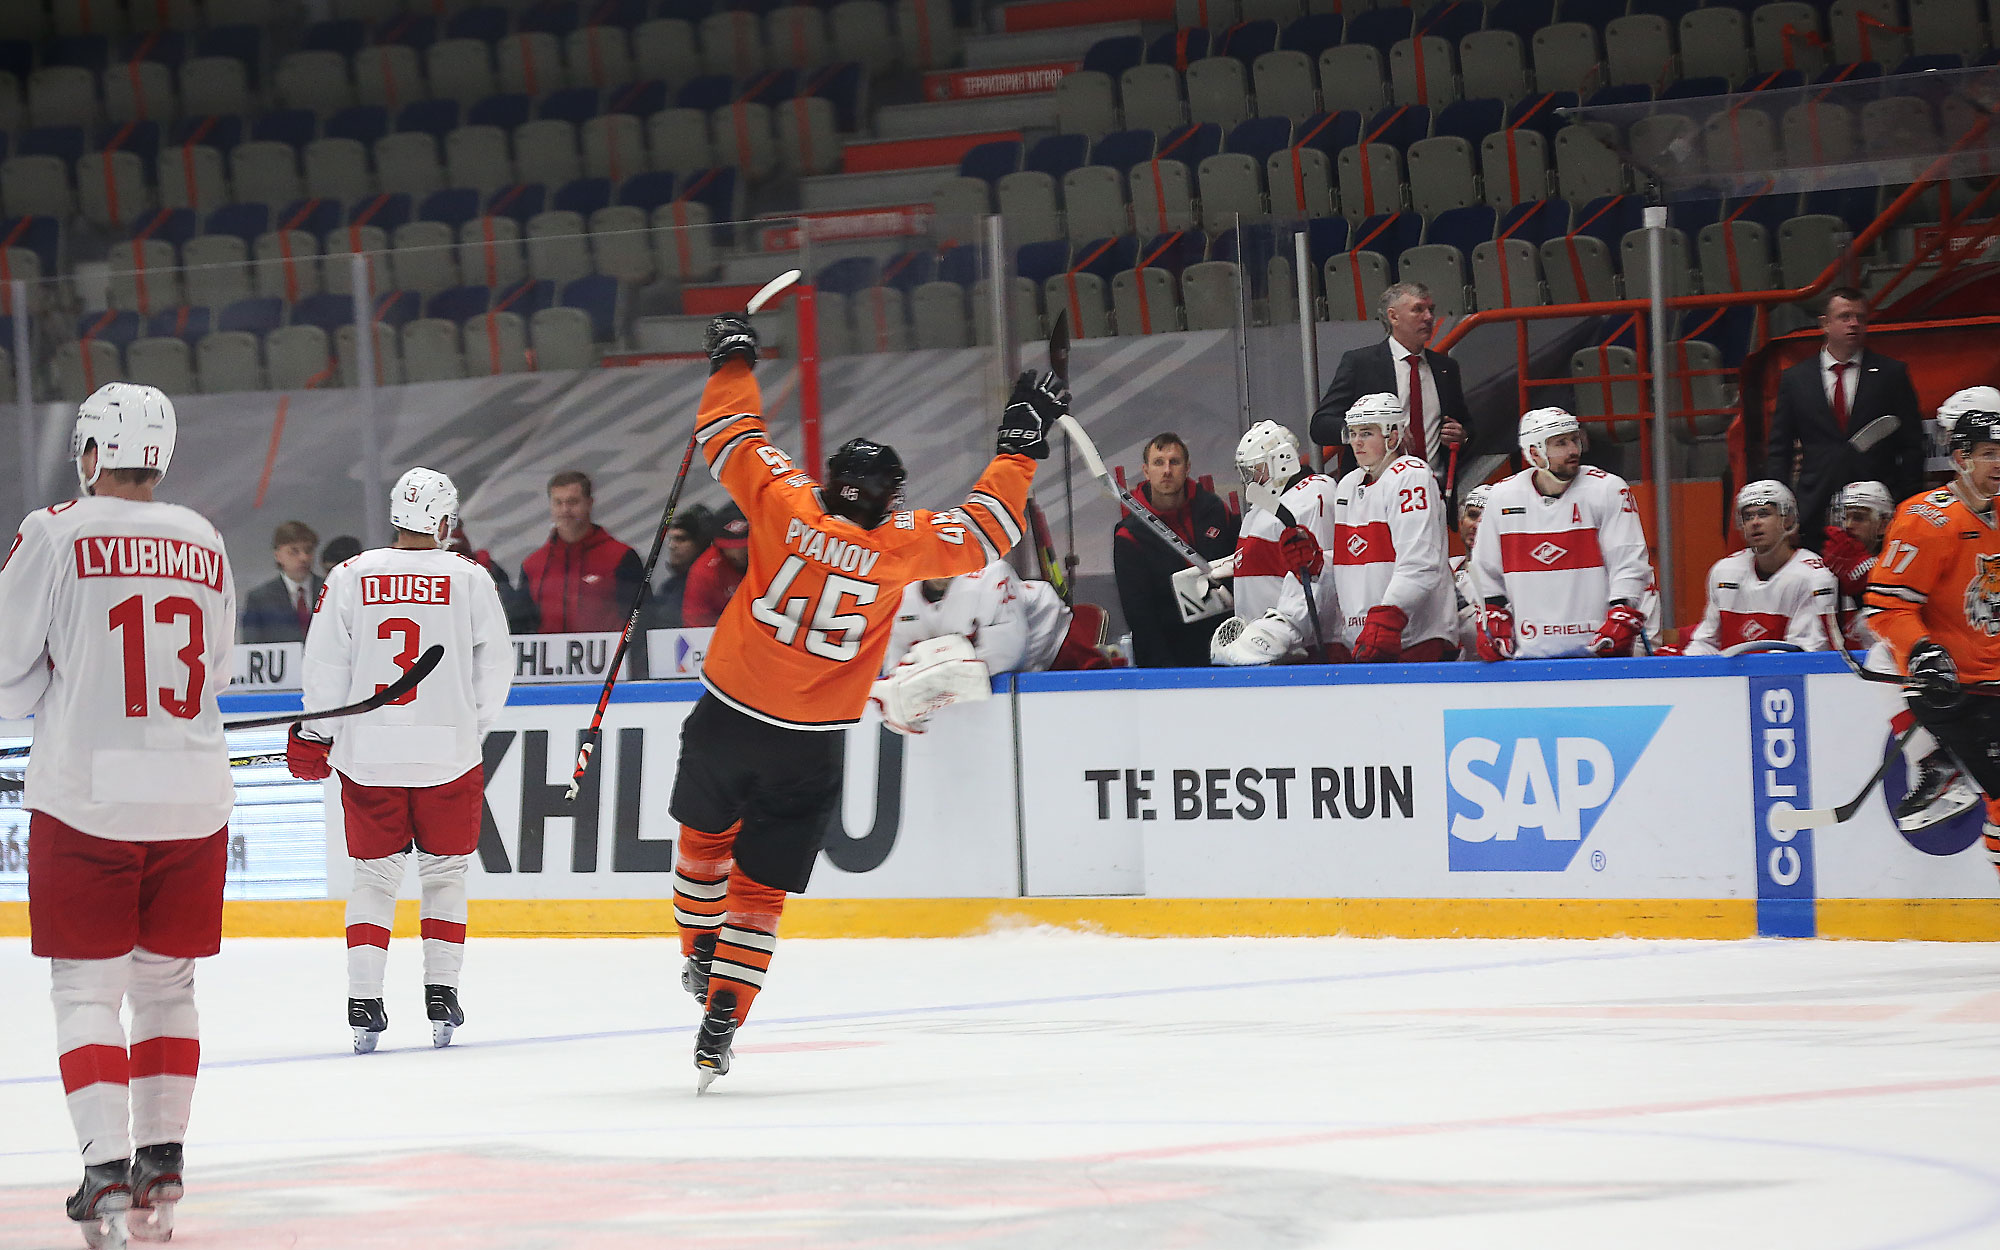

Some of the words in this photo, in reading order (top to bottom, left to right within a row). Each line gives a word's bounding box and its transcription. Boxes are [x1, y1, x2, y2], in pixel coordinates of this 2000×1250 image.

[964, 72, 1025, 95] ТЕРРИТОРИЯ
[143, 445, 160, 467] 13
[405, 487, 418, 503] 3
[1316, 493, 1324, 518] 1
[1399, 485, 1428, 514] 23
[1571, 502, 1583, 524] A
[81, 538, 221, 588] LYUBIMOV
[784, 516, 881, 578] PYANOV
[1881, 539, 1920, 575] 17
[365, 575, 446, 604] DJUSE
[751, 554, 879, 662] 45
[1543, 622, 1596, 635] ERIELL
[109, 595, 206, 720] 13
[375, 617, 421, 705] 3
[512, 640, 607, 677] HL.RU
[1173, 767, 1297, 821] BEST
[1311, 765, 1415, 819] RUN
[1448, 737, 1615, 843] SAP
